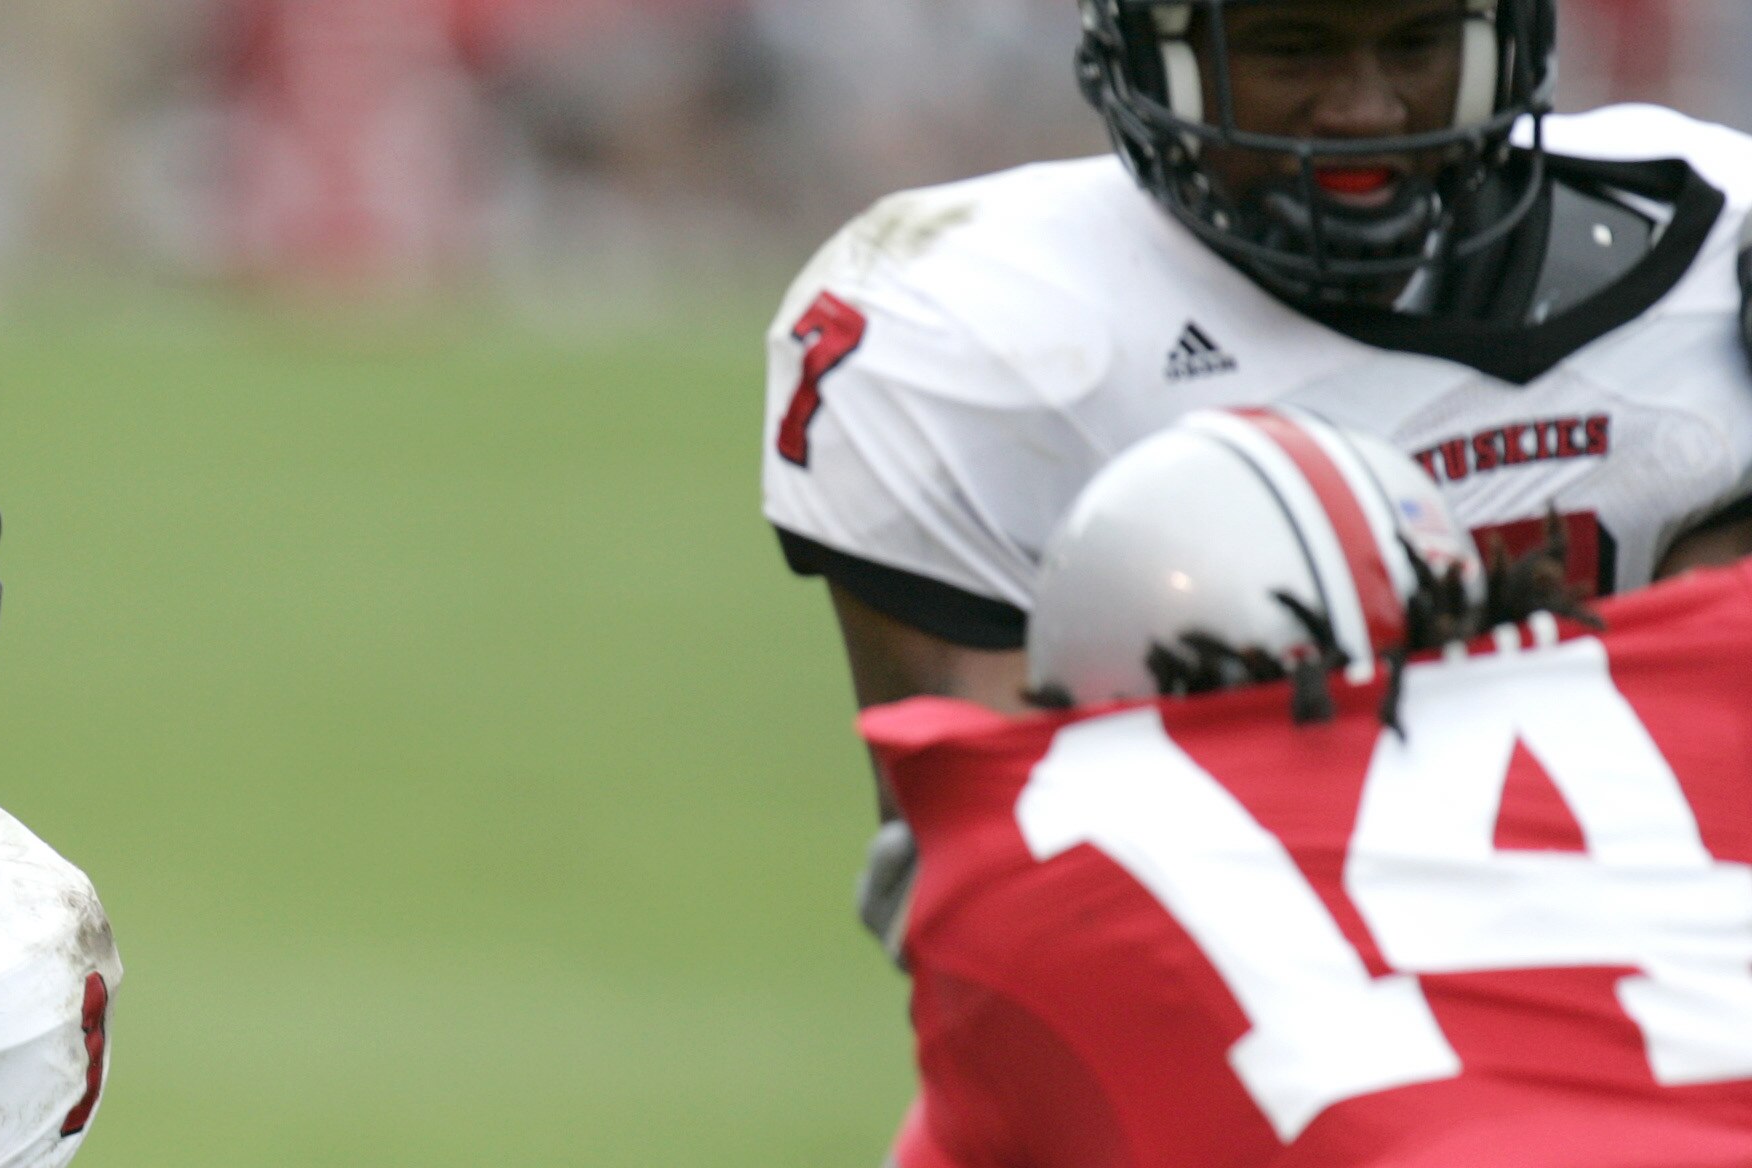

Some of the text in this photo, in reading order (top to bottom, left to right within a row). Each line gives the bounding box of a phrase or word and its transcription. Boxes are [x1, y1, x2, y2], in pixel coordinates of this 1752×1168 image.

[776, 286, 868, 471] 7
[1014, 634, 1752, 1143] 14
[59, 970, 108, 1134] 1
